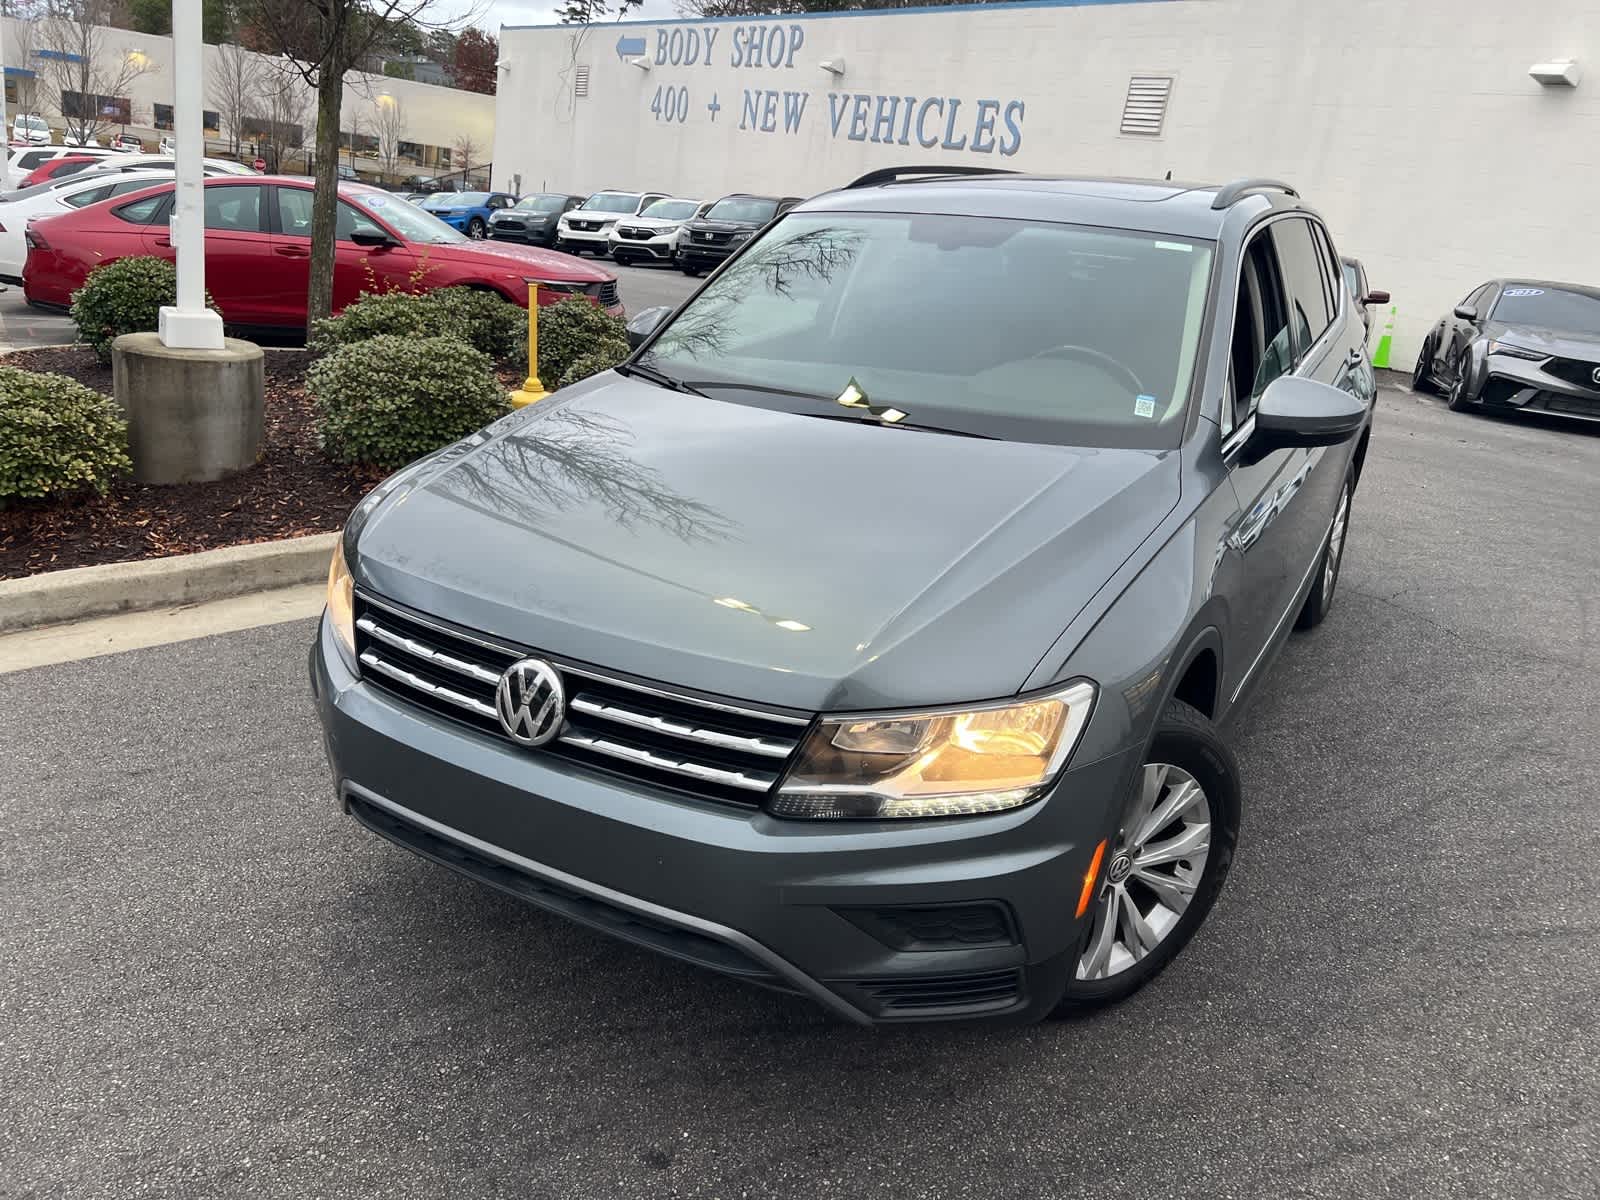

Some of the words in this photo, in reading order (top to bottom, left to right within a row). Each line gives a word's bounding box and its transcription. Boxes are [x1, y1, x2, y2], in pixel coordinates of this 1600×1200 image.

[655, 28, 719, 66] BODY
[731, 25, 804, 68] SHOP
[651, 84, 689, 123] 400
[707, 91, 721, 122] +
[739, 89, 809, 133] NEW
[828, 92, 1025, 156] VEHICLES
